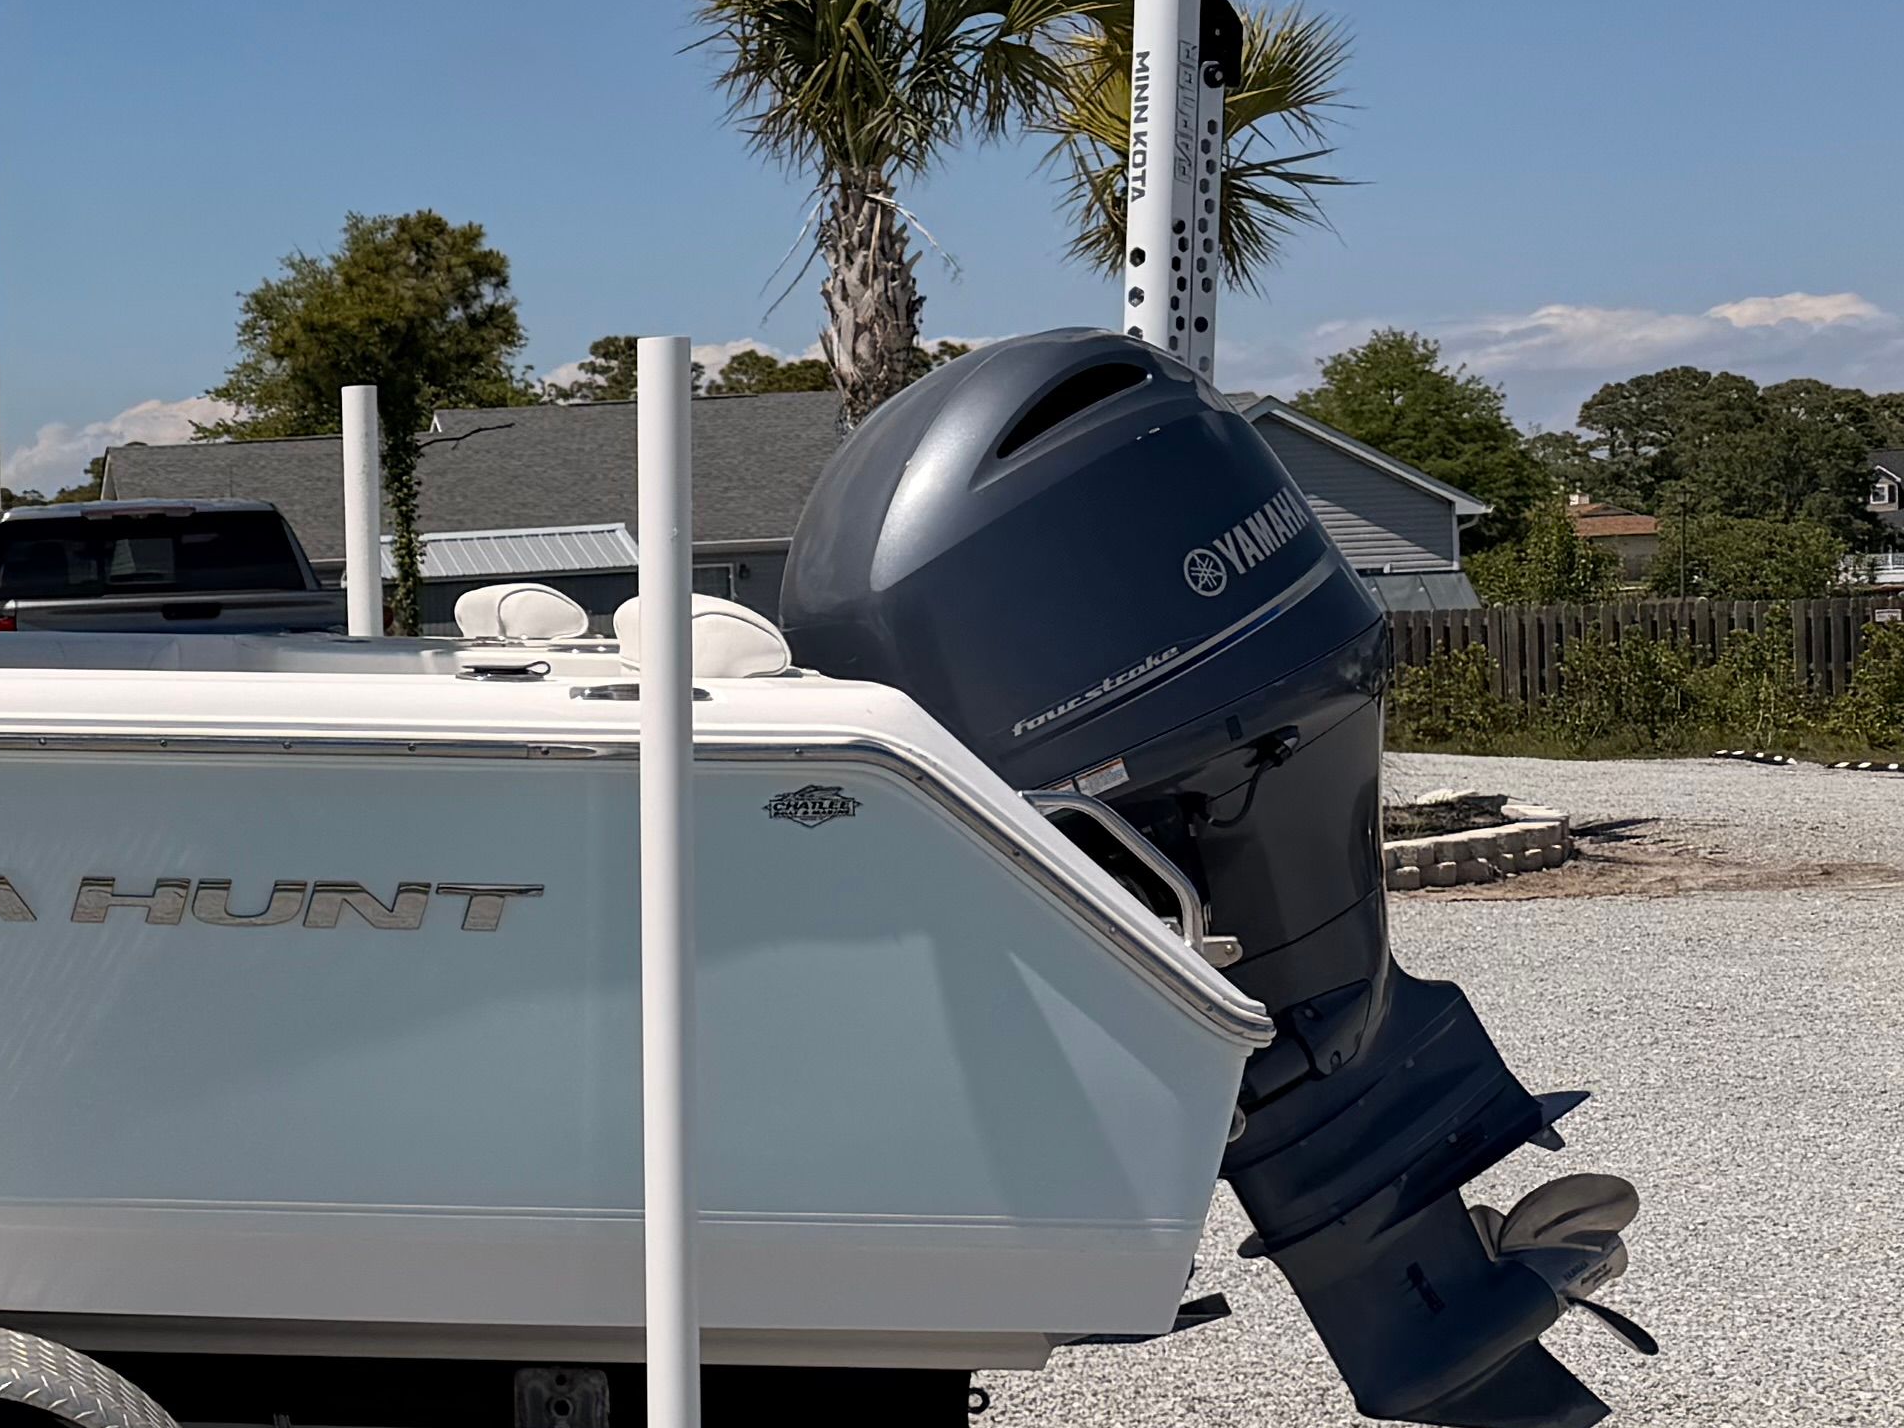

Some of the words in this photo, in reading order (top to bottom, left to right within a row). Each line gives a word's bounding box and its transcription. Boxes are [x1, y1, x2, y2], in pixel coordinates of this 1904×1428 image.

[1133, 50, 1150, 123] MINN
[1130, 131, 1148, 203] KOTA
[1212, 487, 1310, 574] YAMAHA
[1012, 645, 1180, 737] fourstroke
[69, 875, 546, 934] HUNT
